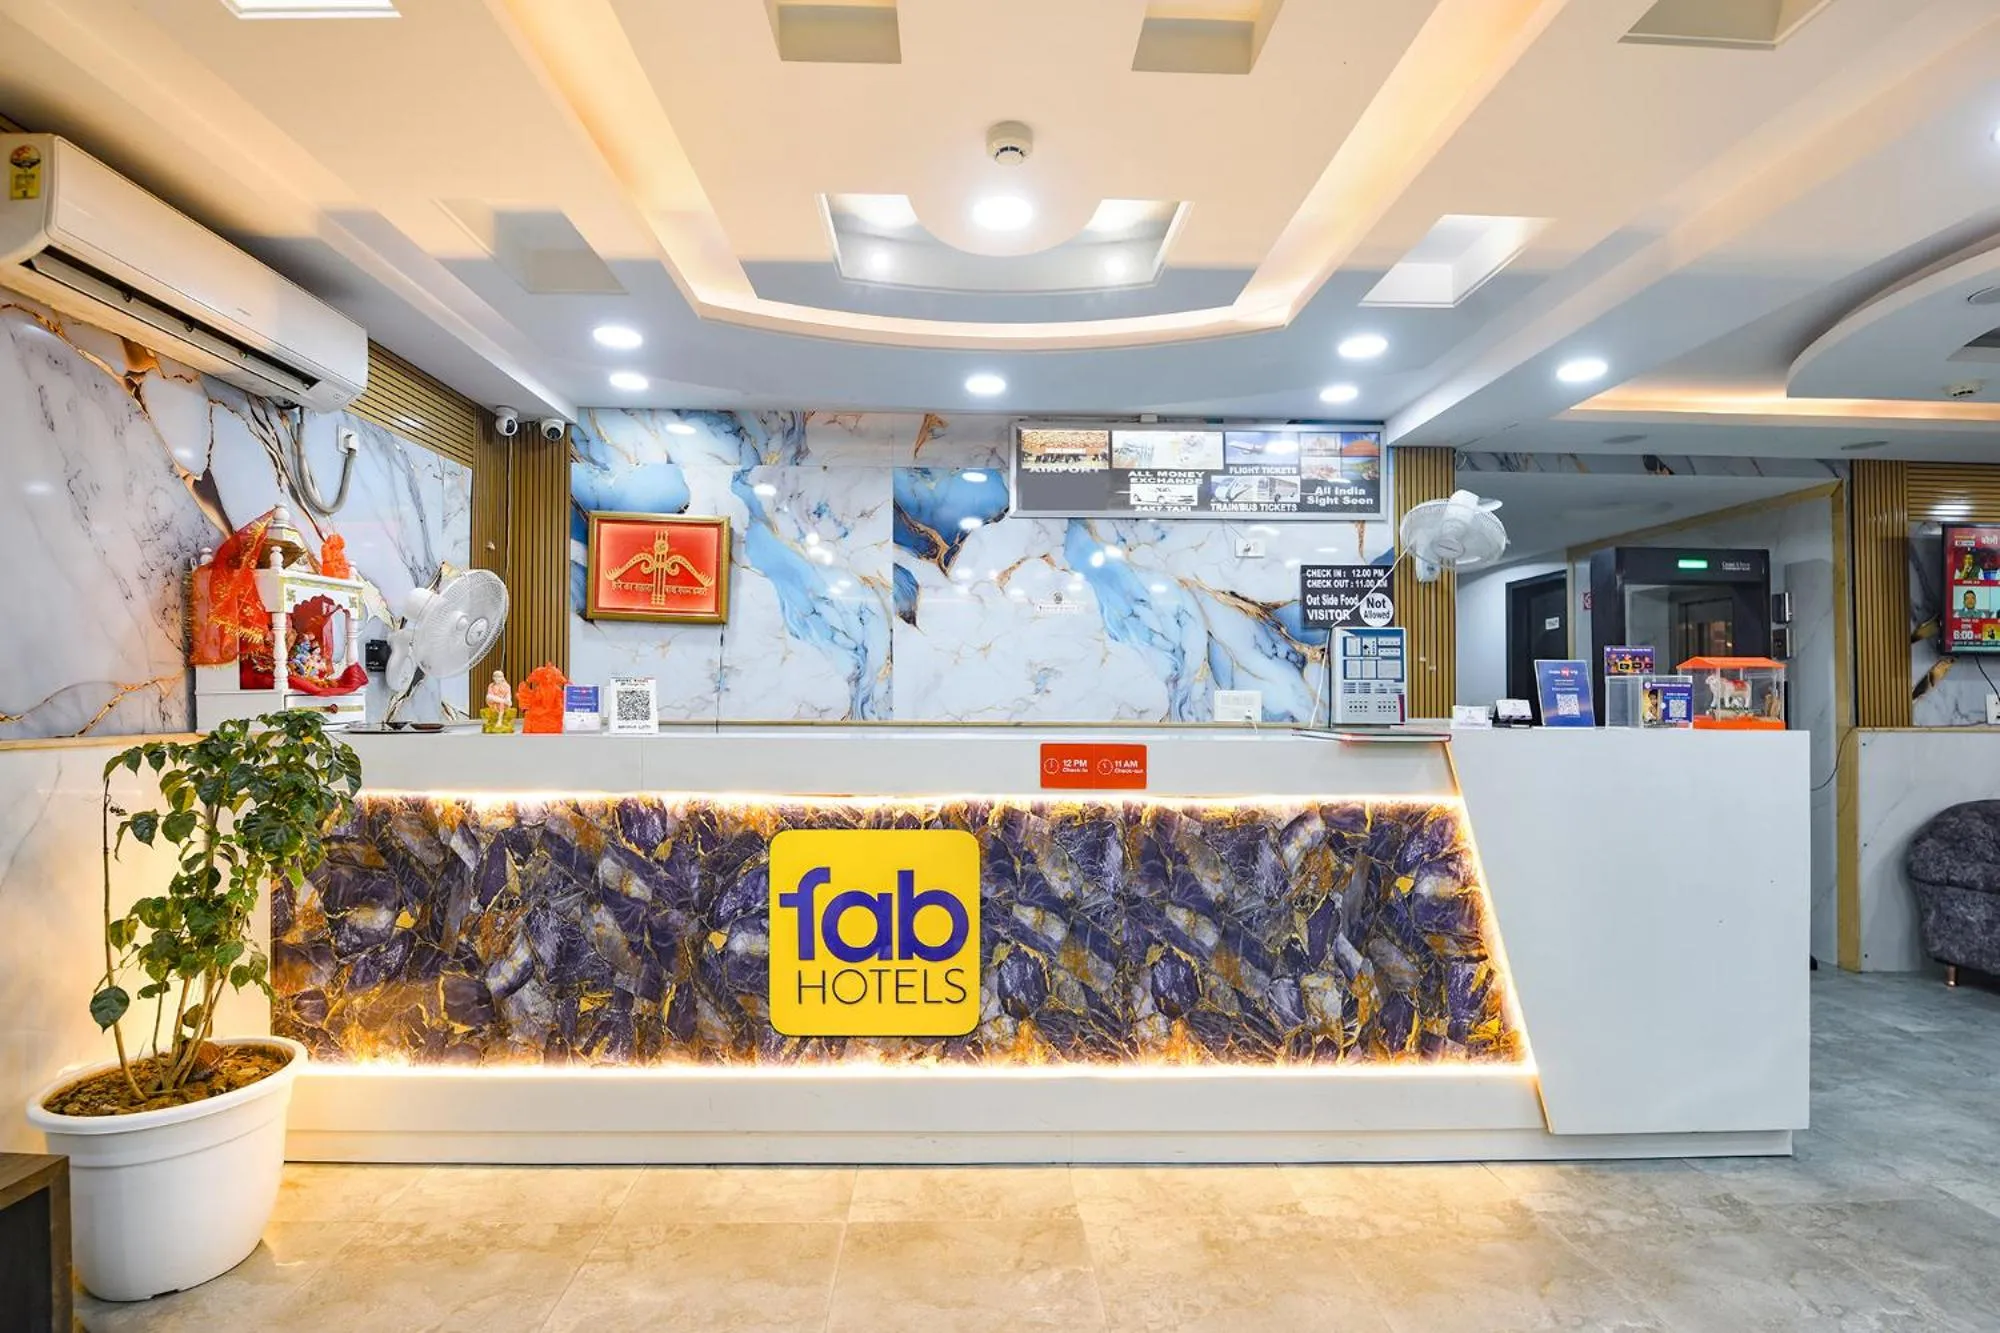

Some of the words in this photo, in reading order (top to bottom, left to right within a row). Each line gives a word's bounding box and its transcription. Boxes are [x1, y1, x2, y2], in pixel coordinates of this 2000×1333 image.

[1315, 486, 1331, 495] All
[1334, 486, 1366, 495] India
[1307, 496, 1339, 506] Sight
[1342, 496, 1373, 504] Seen
[1260, 503, 1297, 512] TICKETS
[1306, 569, 1332, 577] CHECK
[1352, 569, 1371, 577] 12.00
[1373, 569, 1384, 577] PM
[1306, 580, 1332, 588] CHECK
[1306, 593, 1321, 606] Out
[1322, 594, 1338, 606] Side
[1340, 594, 1359, 606] Food
[1367, 598, 1386, 609] Not
[1307, 609, 1351, 620] VISITOR
[1364, 610, 1390, 619] Allowed
[1123, 760, 1138, 768] AM
[779, 866, 969, 963] fab
[798, 968, 967, 1005] HOTELS
